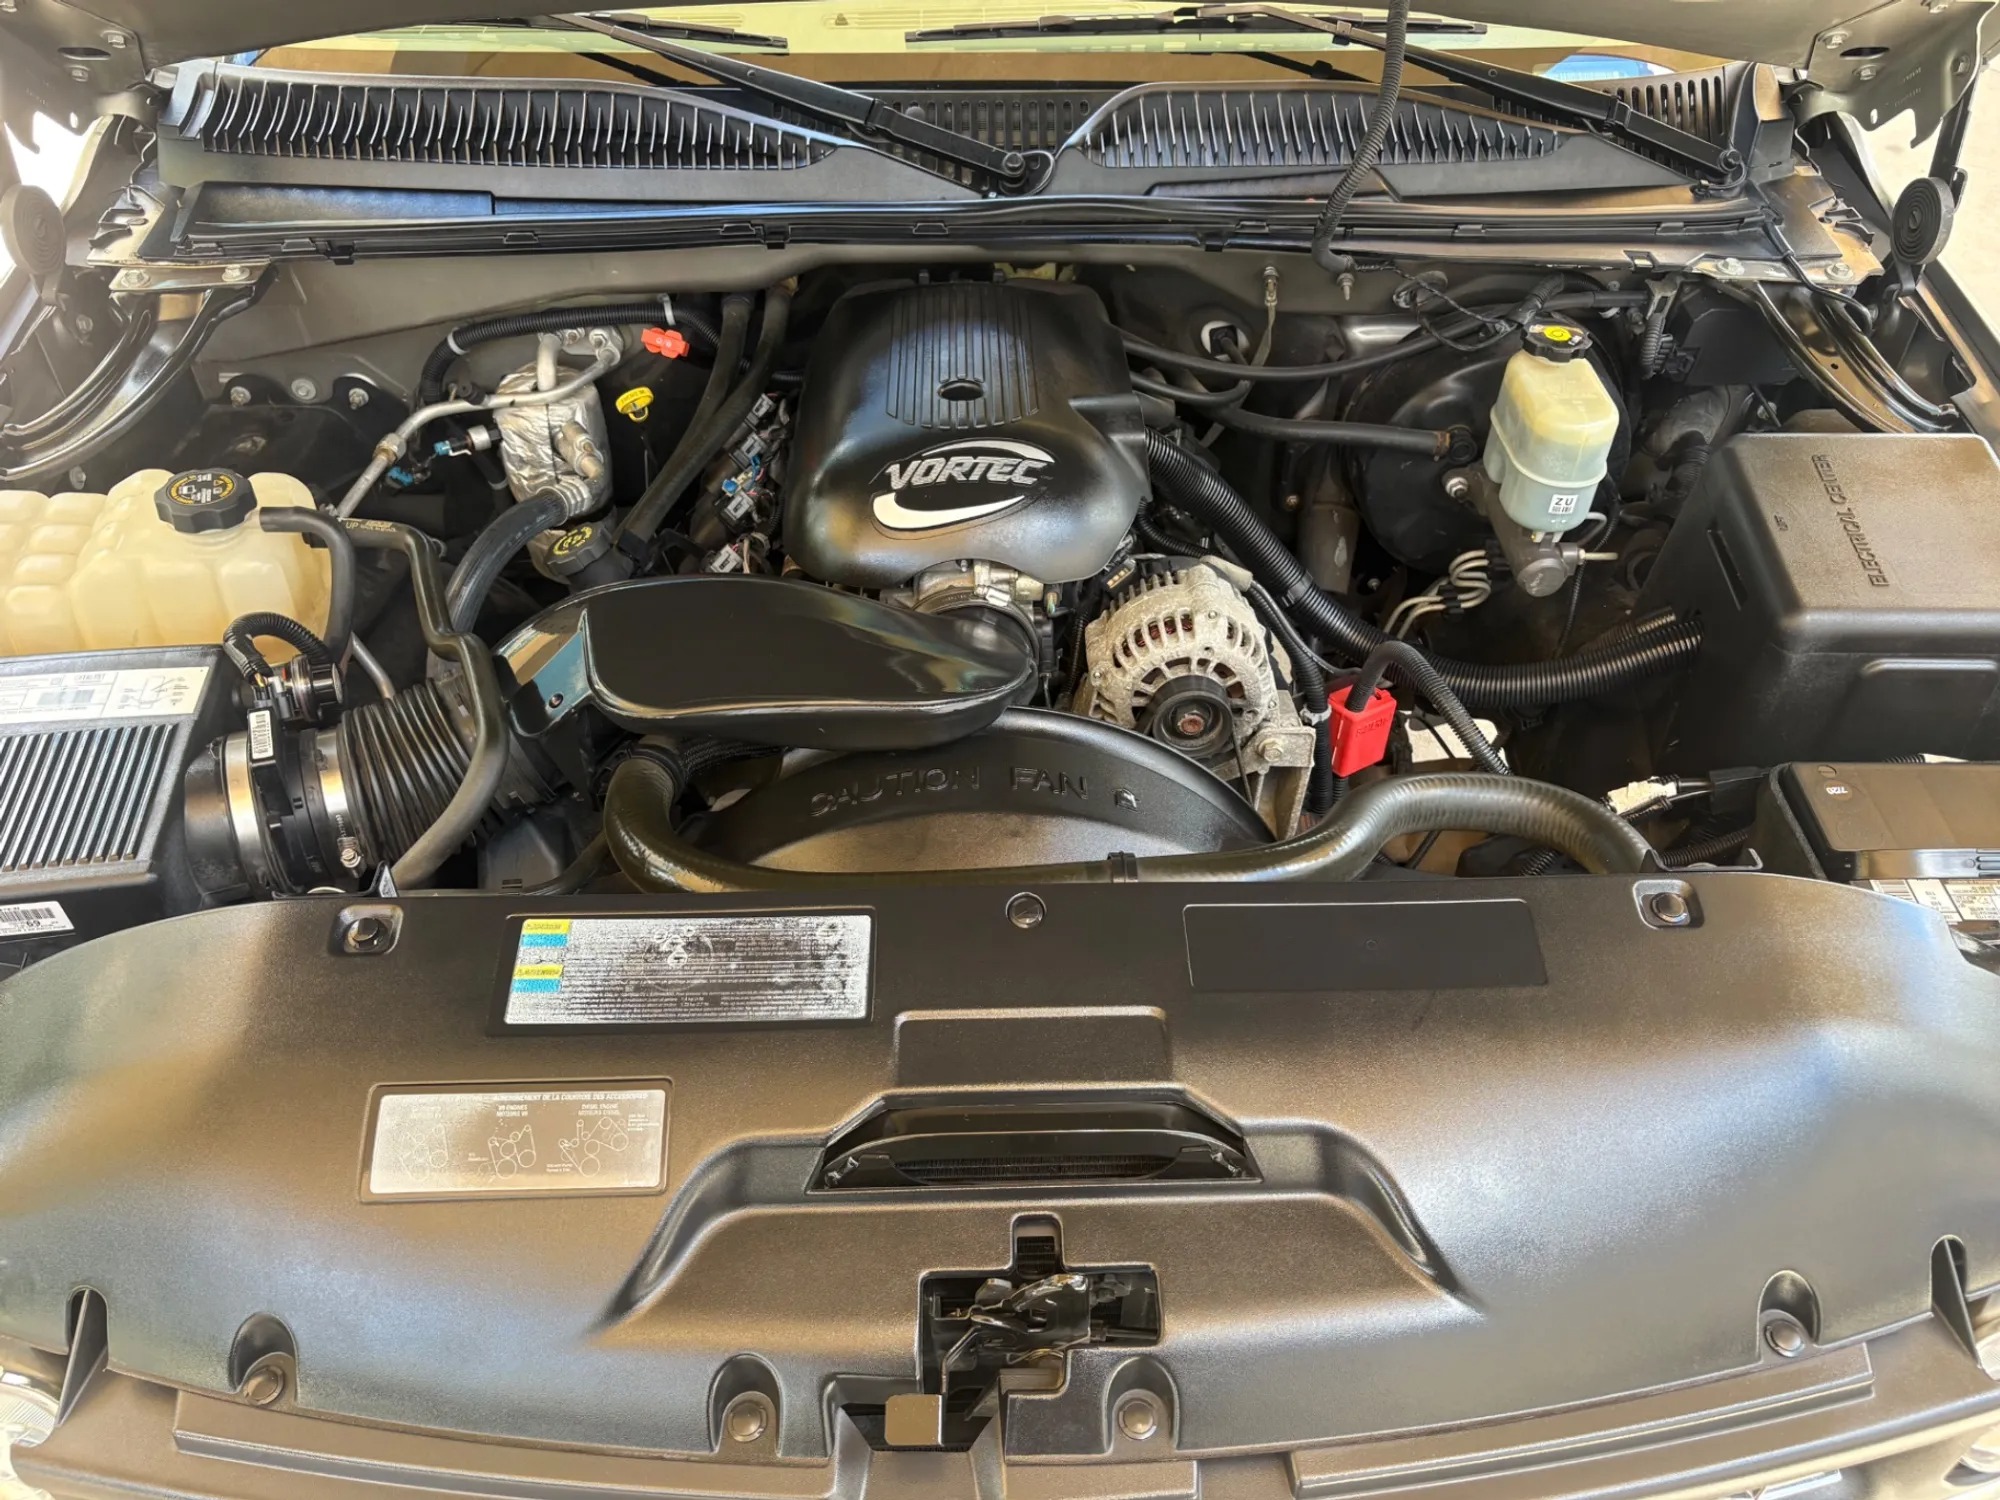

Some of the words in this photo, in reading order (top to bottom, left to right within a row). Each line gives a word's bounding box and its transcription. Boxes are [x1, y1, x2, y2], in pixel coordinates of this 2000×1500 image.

[885, 456, 1048, 490] VORTEC
[1836, 507, 1889, 587] ELECTRICAL
[811, 766, 980, 816] CAUTION
[1010, 766, 1089, 800] FAN
